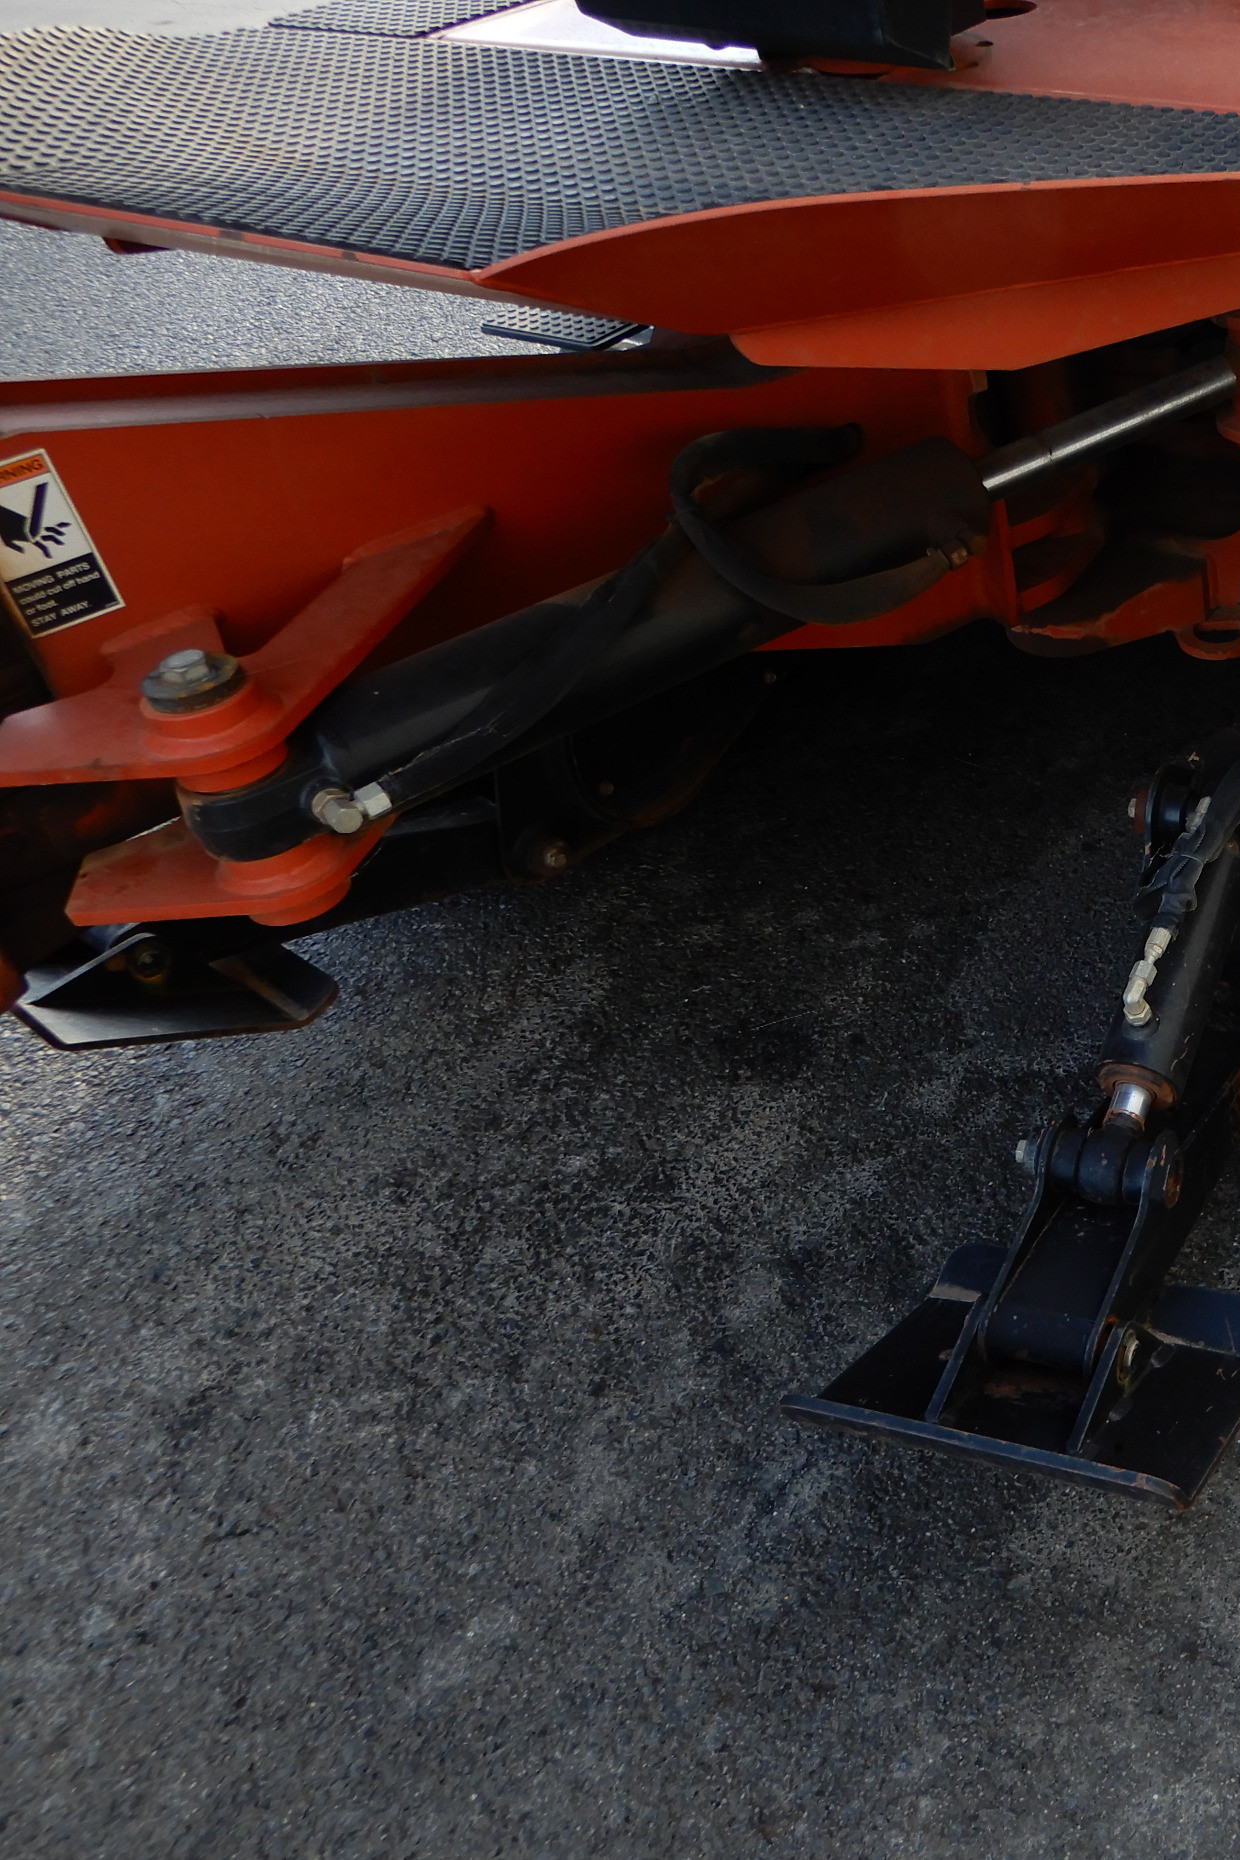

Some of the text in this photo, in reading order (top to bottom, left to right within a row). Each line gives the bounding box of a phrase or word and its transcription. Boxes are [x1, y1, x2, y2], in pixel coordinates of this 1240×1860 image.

[13, 562, 91, 594] MOVING PARTS
[19, 571, 100, 605] could cut off hand
[31, 613, 57, 627] STAY
